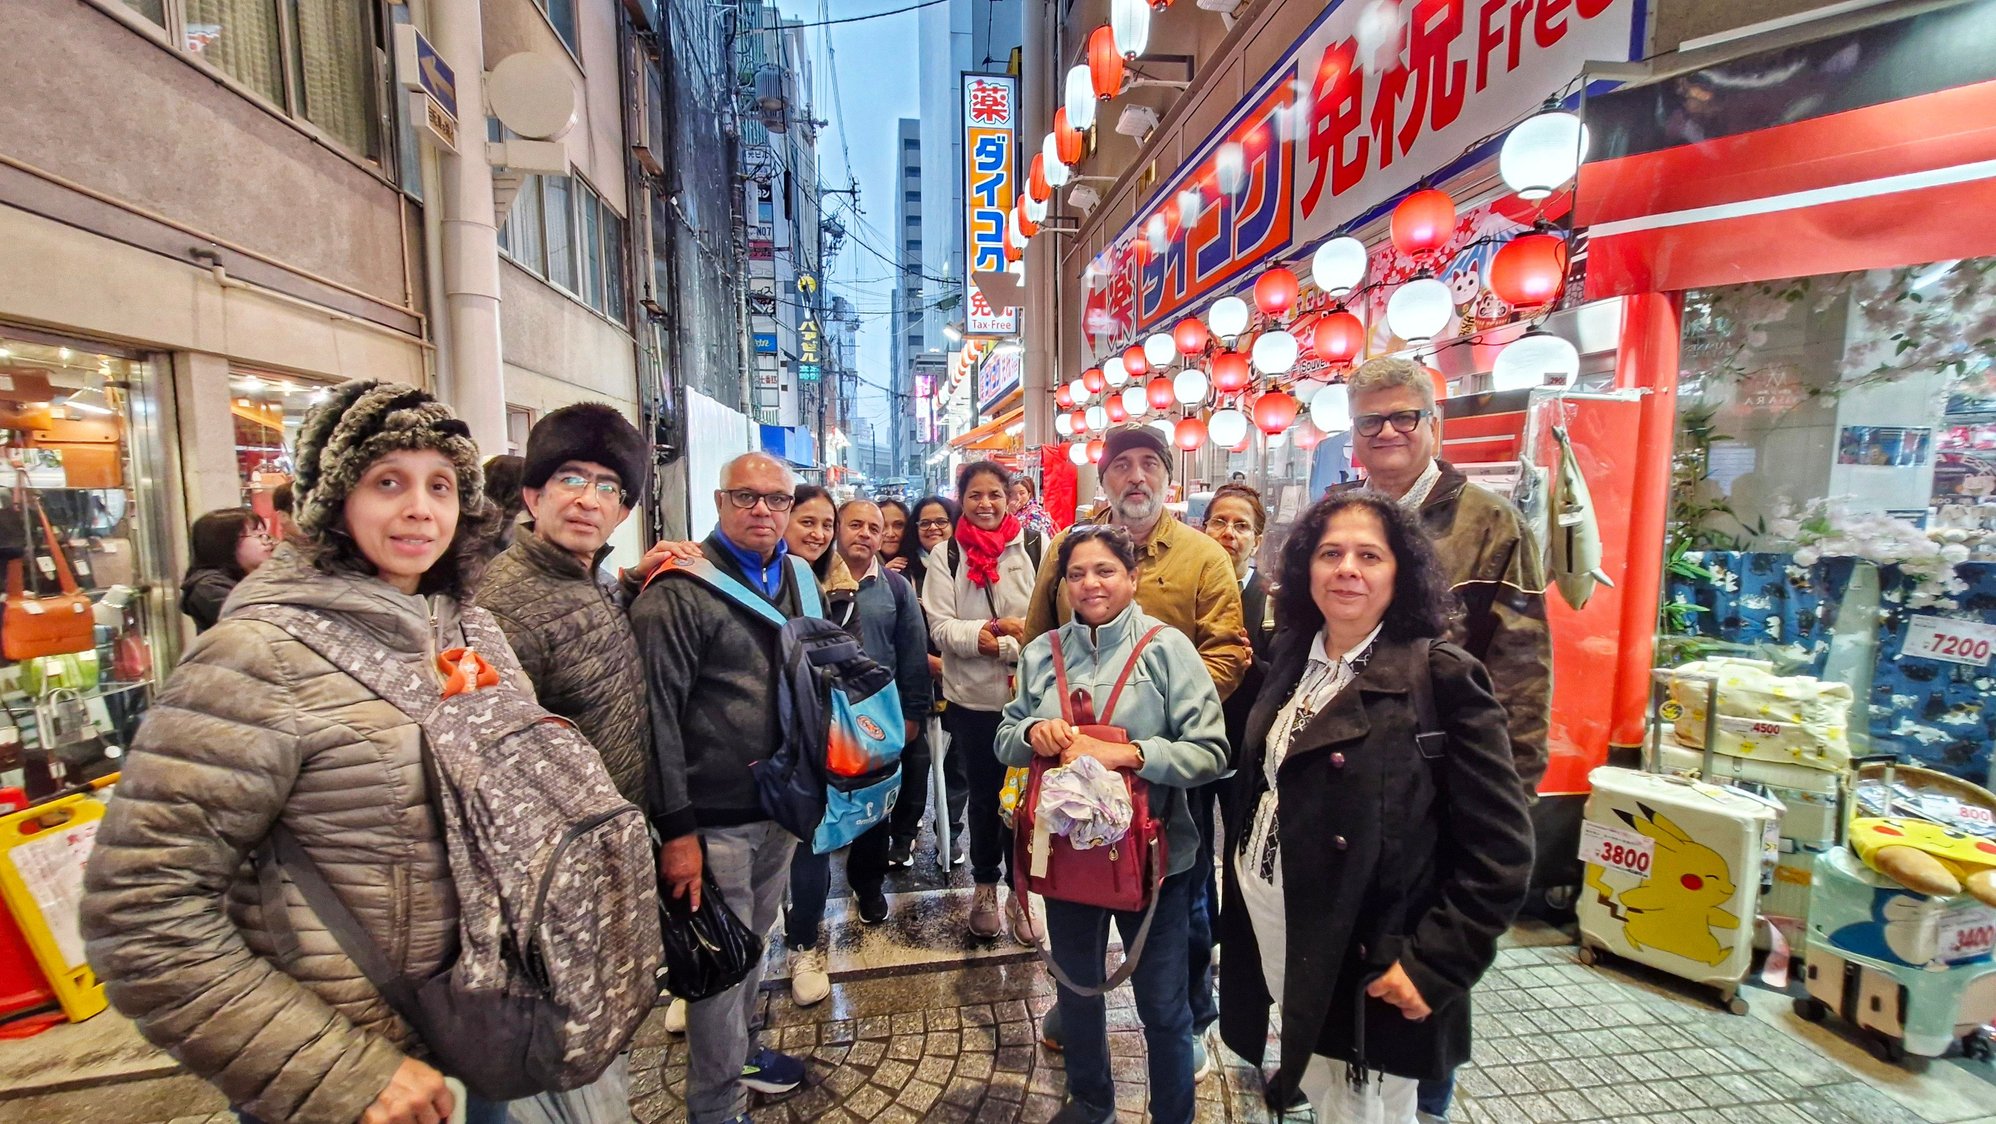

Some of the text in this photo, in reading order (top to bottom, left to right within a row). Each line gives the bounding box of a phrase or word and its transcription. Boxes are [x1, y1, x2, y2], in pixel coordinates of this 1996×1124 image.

[972, 85, 1008, 122] 薬
[974, 135, 1006, 273] ダイコク
[971, 291, 1013, 317] 免
[1108, 242, 1135, 346] 薬
[1931, 633, 1989, 659] 7200
[1753, 723, 1780, 735] 4500
[1601, 842, 1649, 872] 3800
